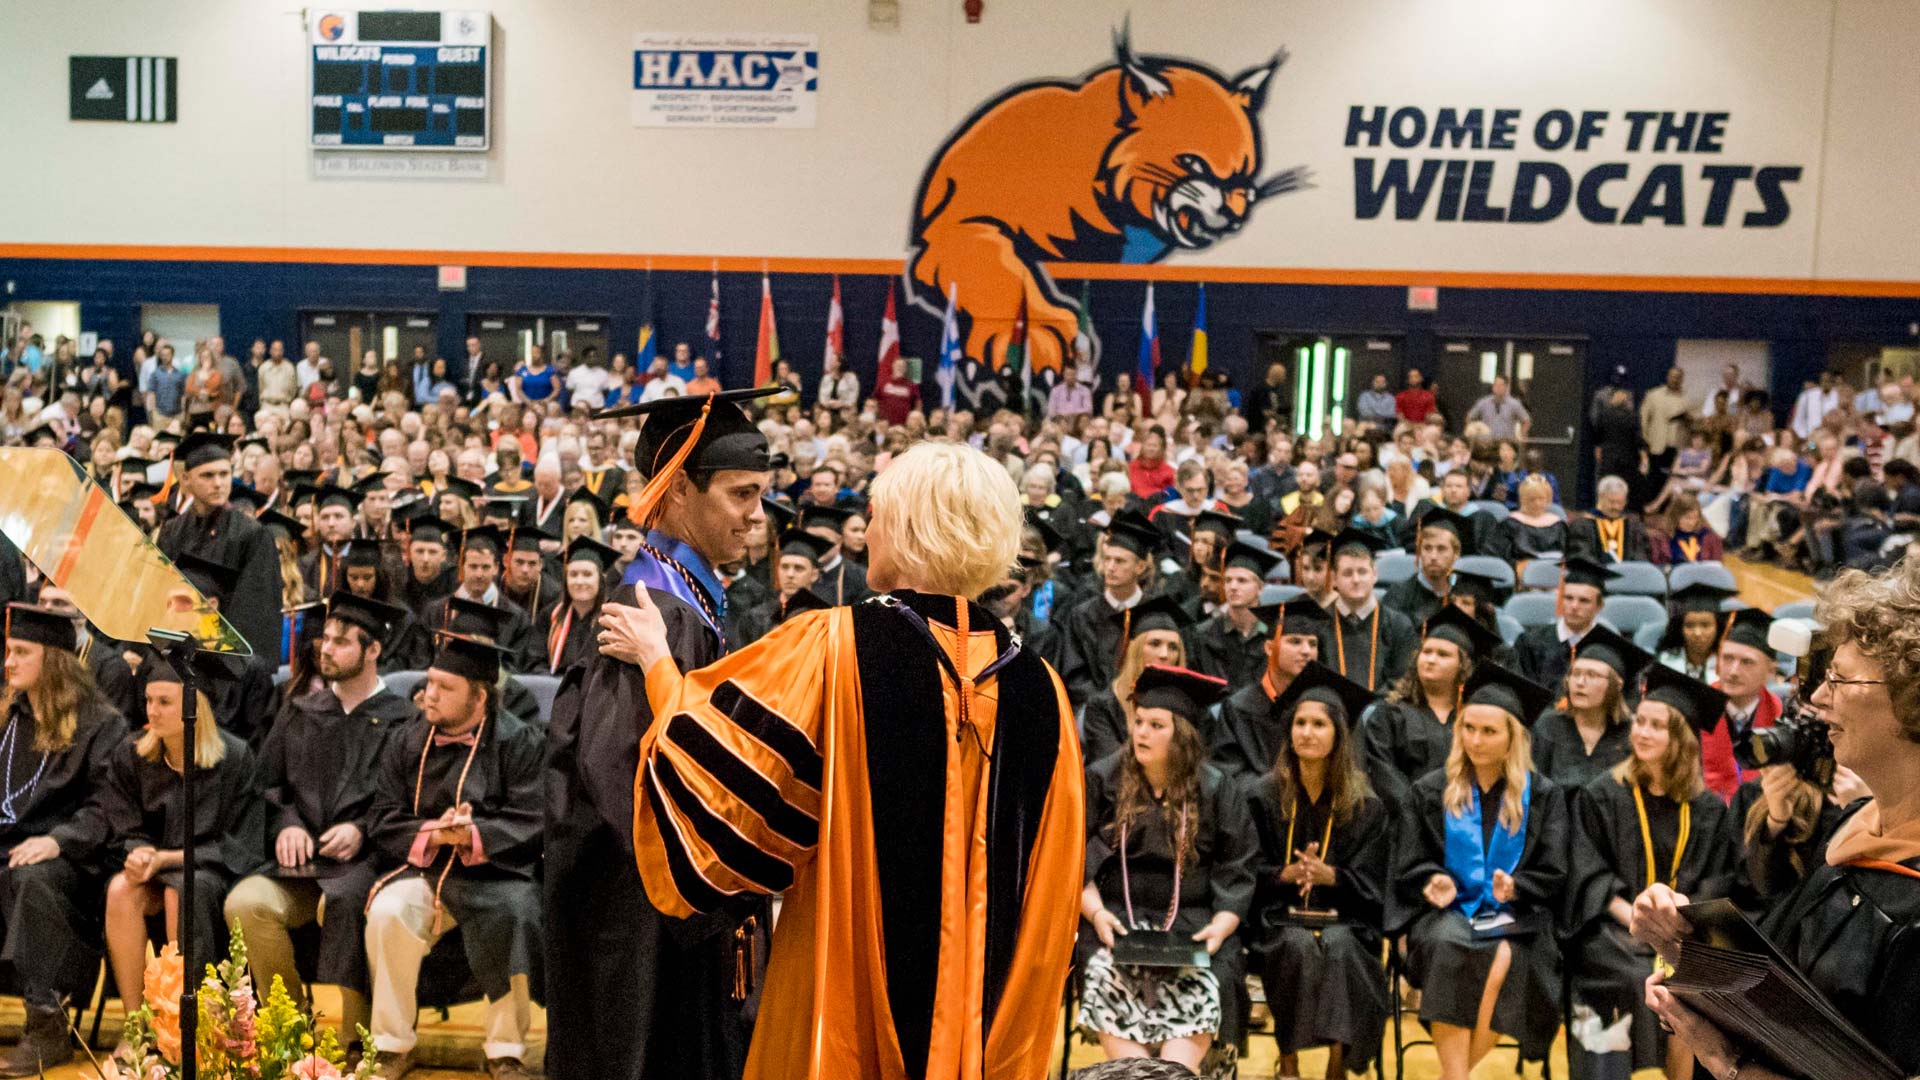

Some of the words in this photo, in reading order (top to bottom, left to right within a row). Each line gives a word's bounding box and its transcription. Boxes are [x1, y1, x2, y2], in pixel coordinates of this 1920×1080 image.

[316, 46, 381, 61] WILDCATS
[437, 47, 481, 62] GUEST
[639, 53, 770, 87] HAAC
[1344, 105, 1521, 151] HOME
[1533, 109, 1610, 153] OF
[1623, 111, 1731, 154] THE
[1353, 157, 1804, 229] WILDCATS
